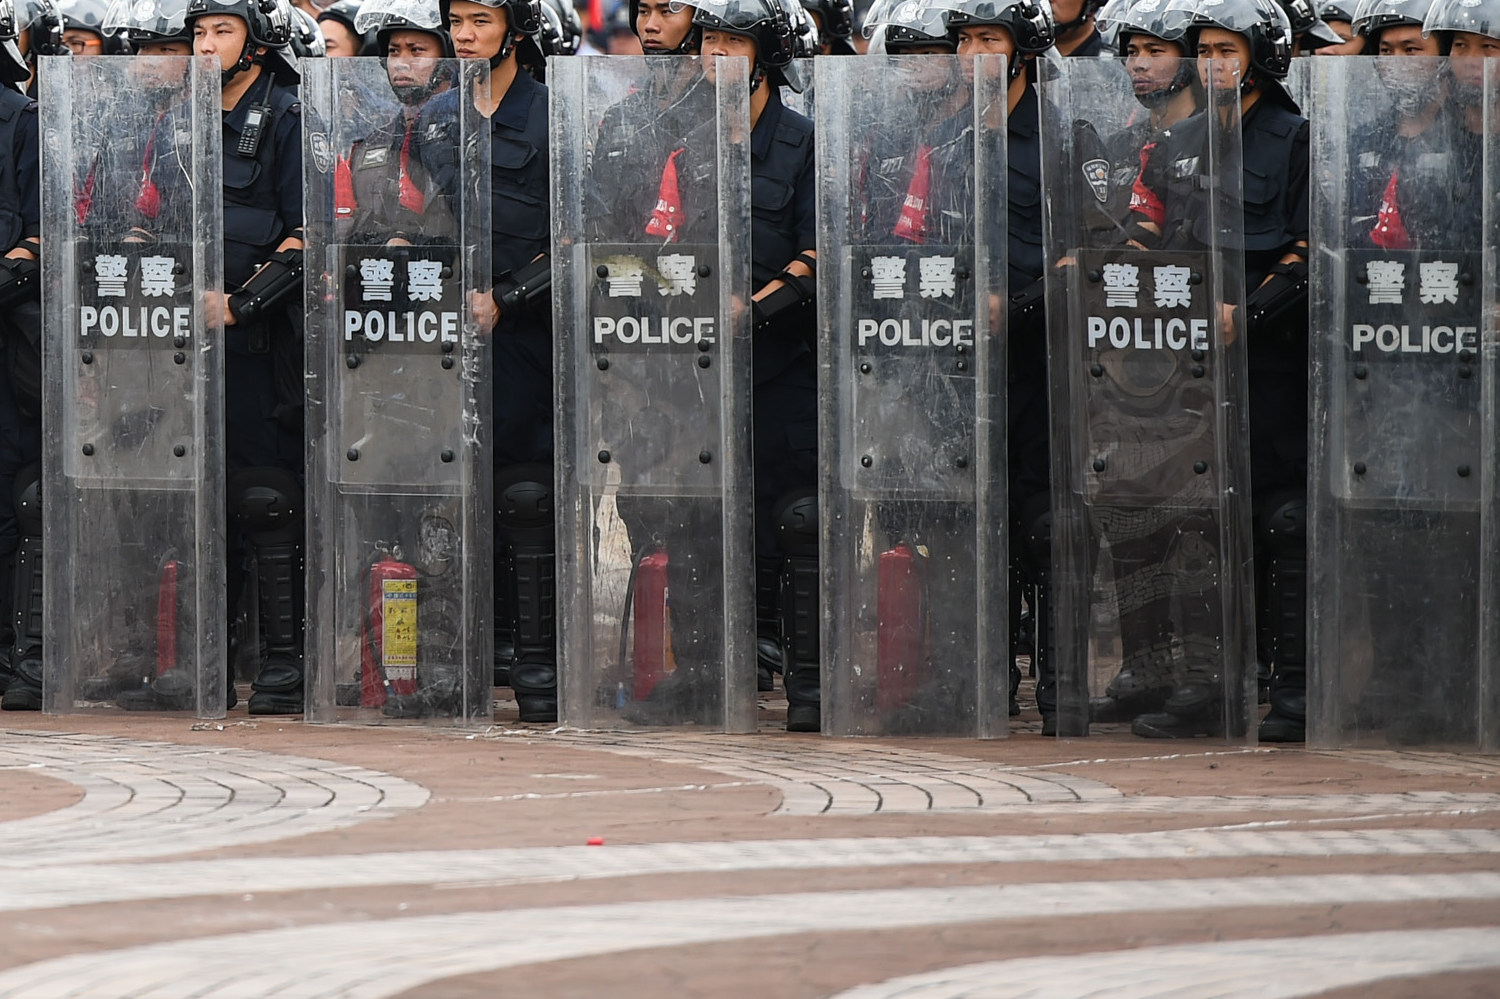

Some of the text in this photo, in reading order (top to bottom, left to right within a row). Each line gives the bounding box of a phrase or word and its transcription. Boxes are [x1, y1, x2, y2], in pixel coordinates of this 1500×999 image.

[94, 254, 176, 298] 警察
[359, 258, 443, 302] 警察
[871, 255, 955, 299] 警察
[1102, 263, 1191, 309] 警察
[1366, 260, 1459, 305] 警察
[80, 306, 190, 338] POLICE
[345, 310, 458, 342] POLICE
[594, 316, 716, 344] POLICE
[858, 319, 973, 346] POLICE
[1087, 317, 1208, 351] POLICE
[1353, 325, 1477, 354] POLICE
